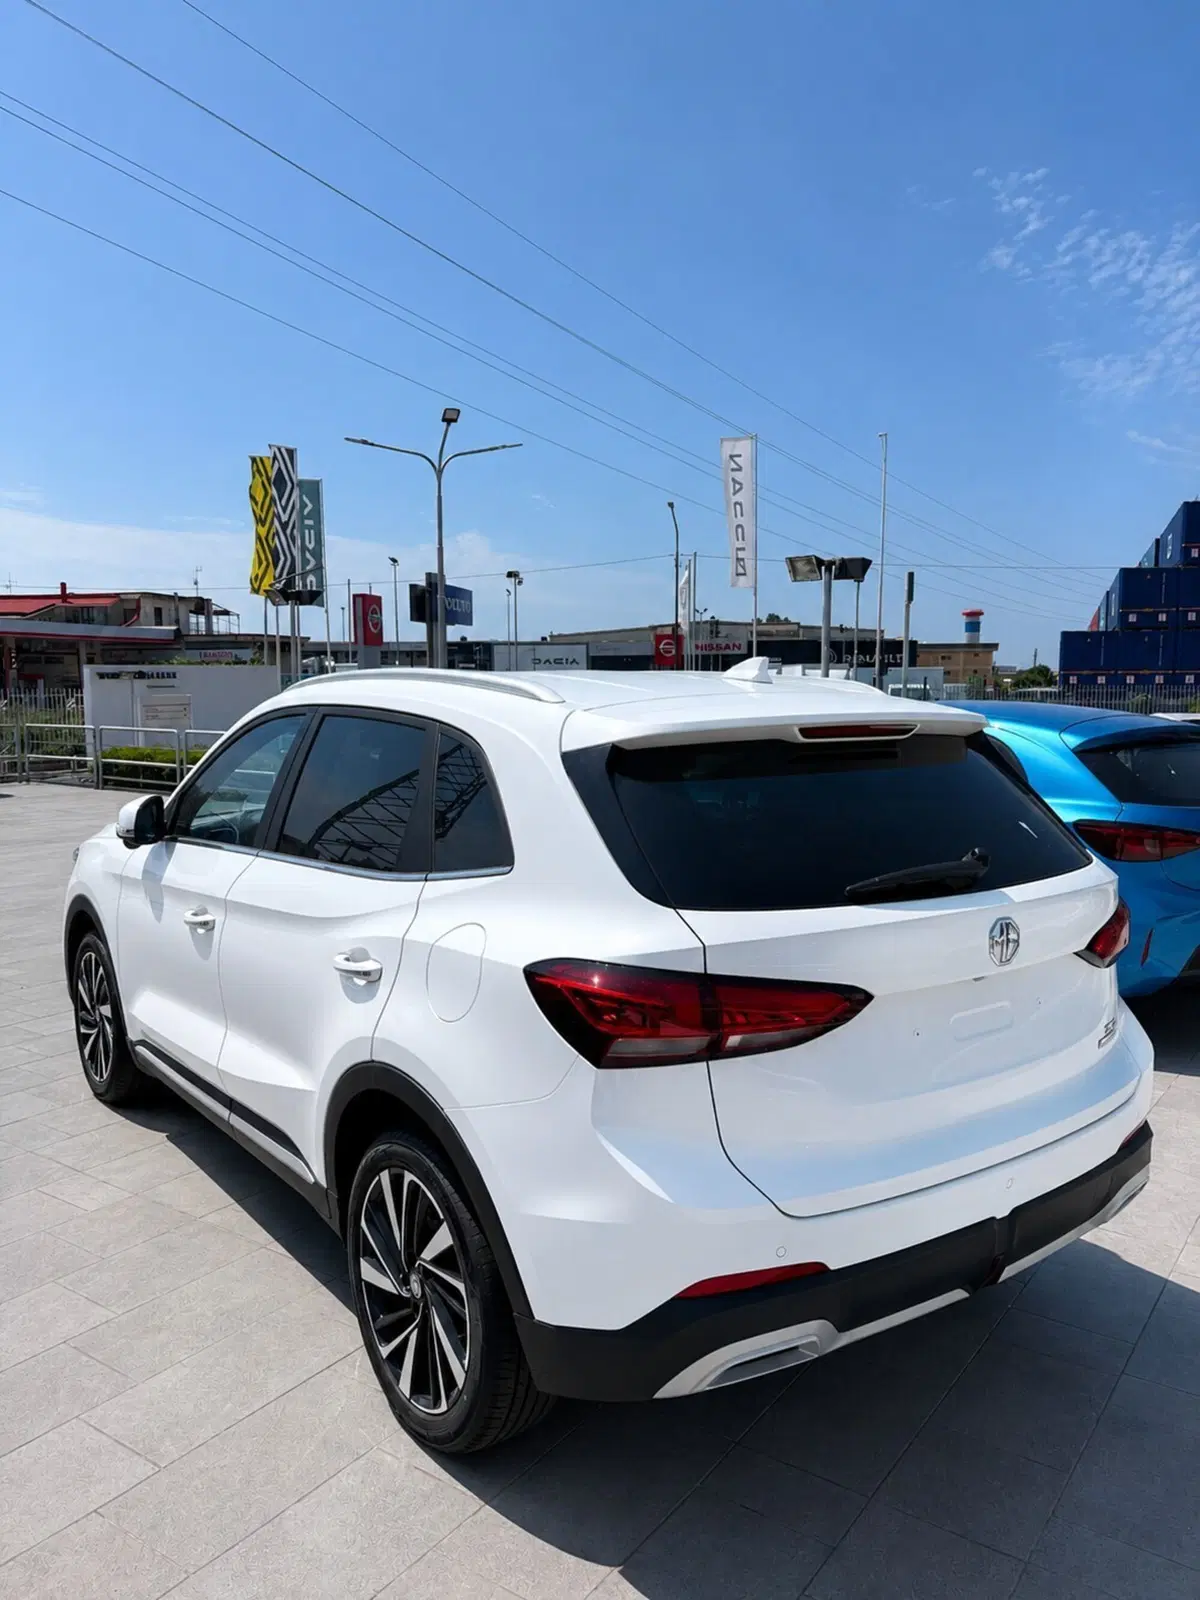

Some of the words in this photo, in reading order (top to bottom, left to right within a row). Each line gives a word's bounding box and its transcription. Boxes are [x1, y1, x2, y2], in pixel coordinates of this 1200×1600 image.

[694, 642, 742, 652] NISSAN
[531, 657, 580, 665] DACIA
[990, 919, 1020, 963] MG
